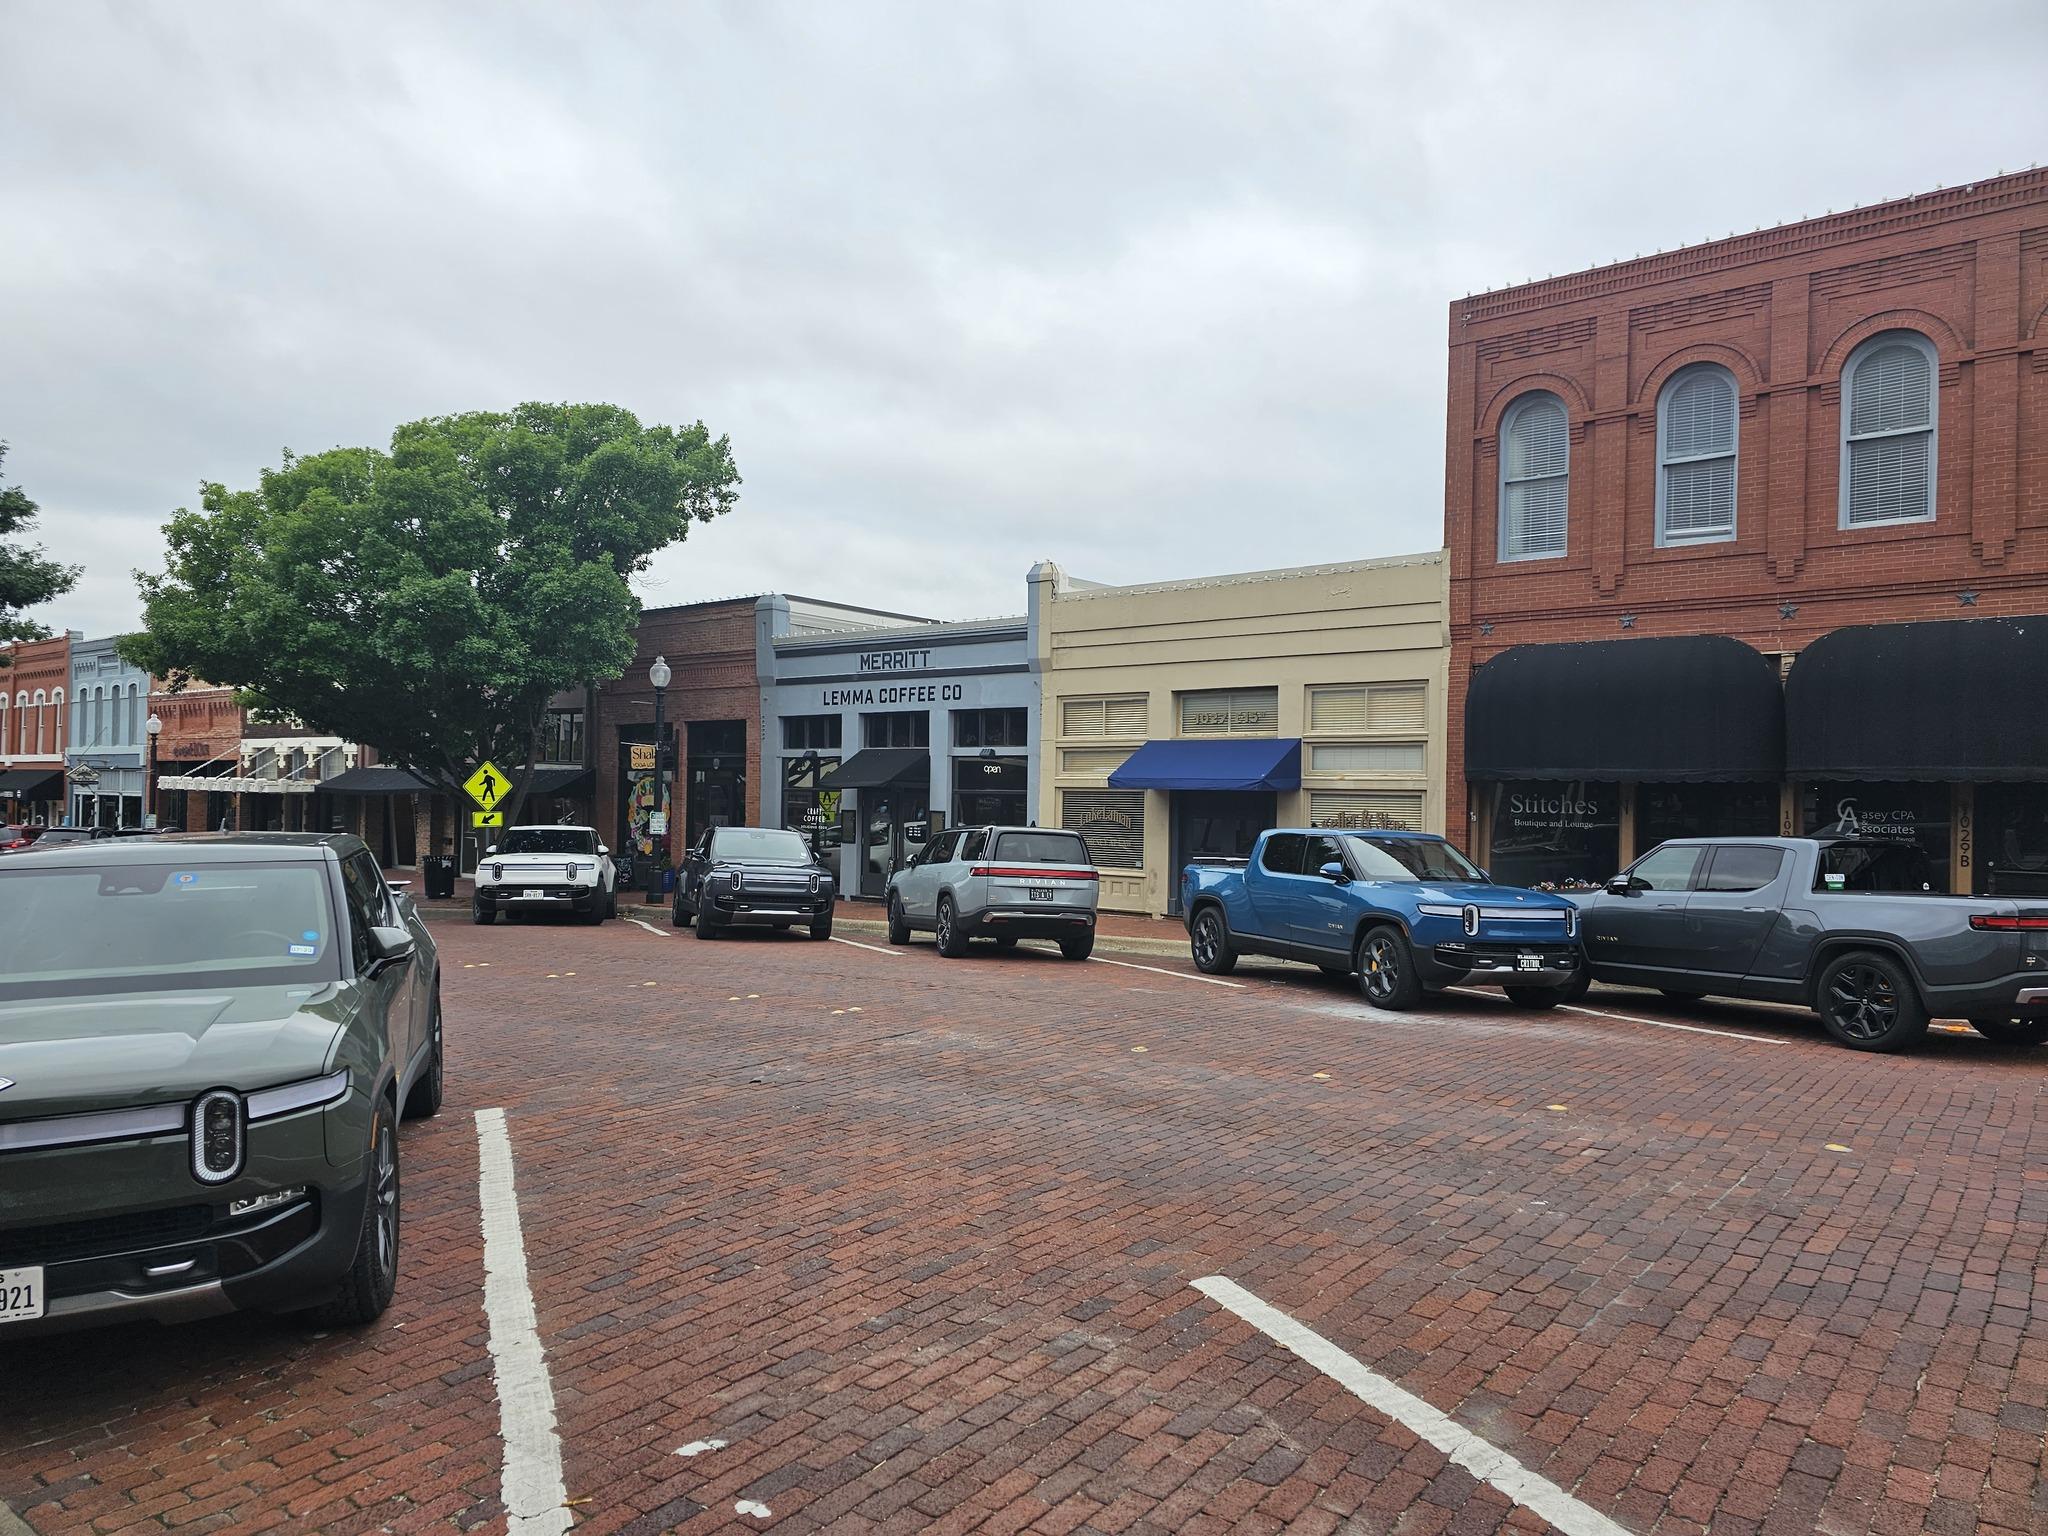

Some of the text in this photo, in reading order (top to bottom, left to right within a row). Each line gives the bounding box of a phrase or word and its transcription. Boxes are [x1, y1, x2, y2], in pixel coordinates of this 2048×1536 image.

[860, 650, 930, 670] MERRITT
[823, 684, 962, 705] LEMMA COFFEE CO
[632, 748, 656, 760] Shal
[983, 765, 1002, 774] open
[1510, 793, 1598, 815] Stitches
[803, 815, 825, 823] COFFEE
[1891, 810, 1916, 820] CPA
[1514, 818, 1547, 828] Boutique
[1565, 820, 1594, 829] Lounge
